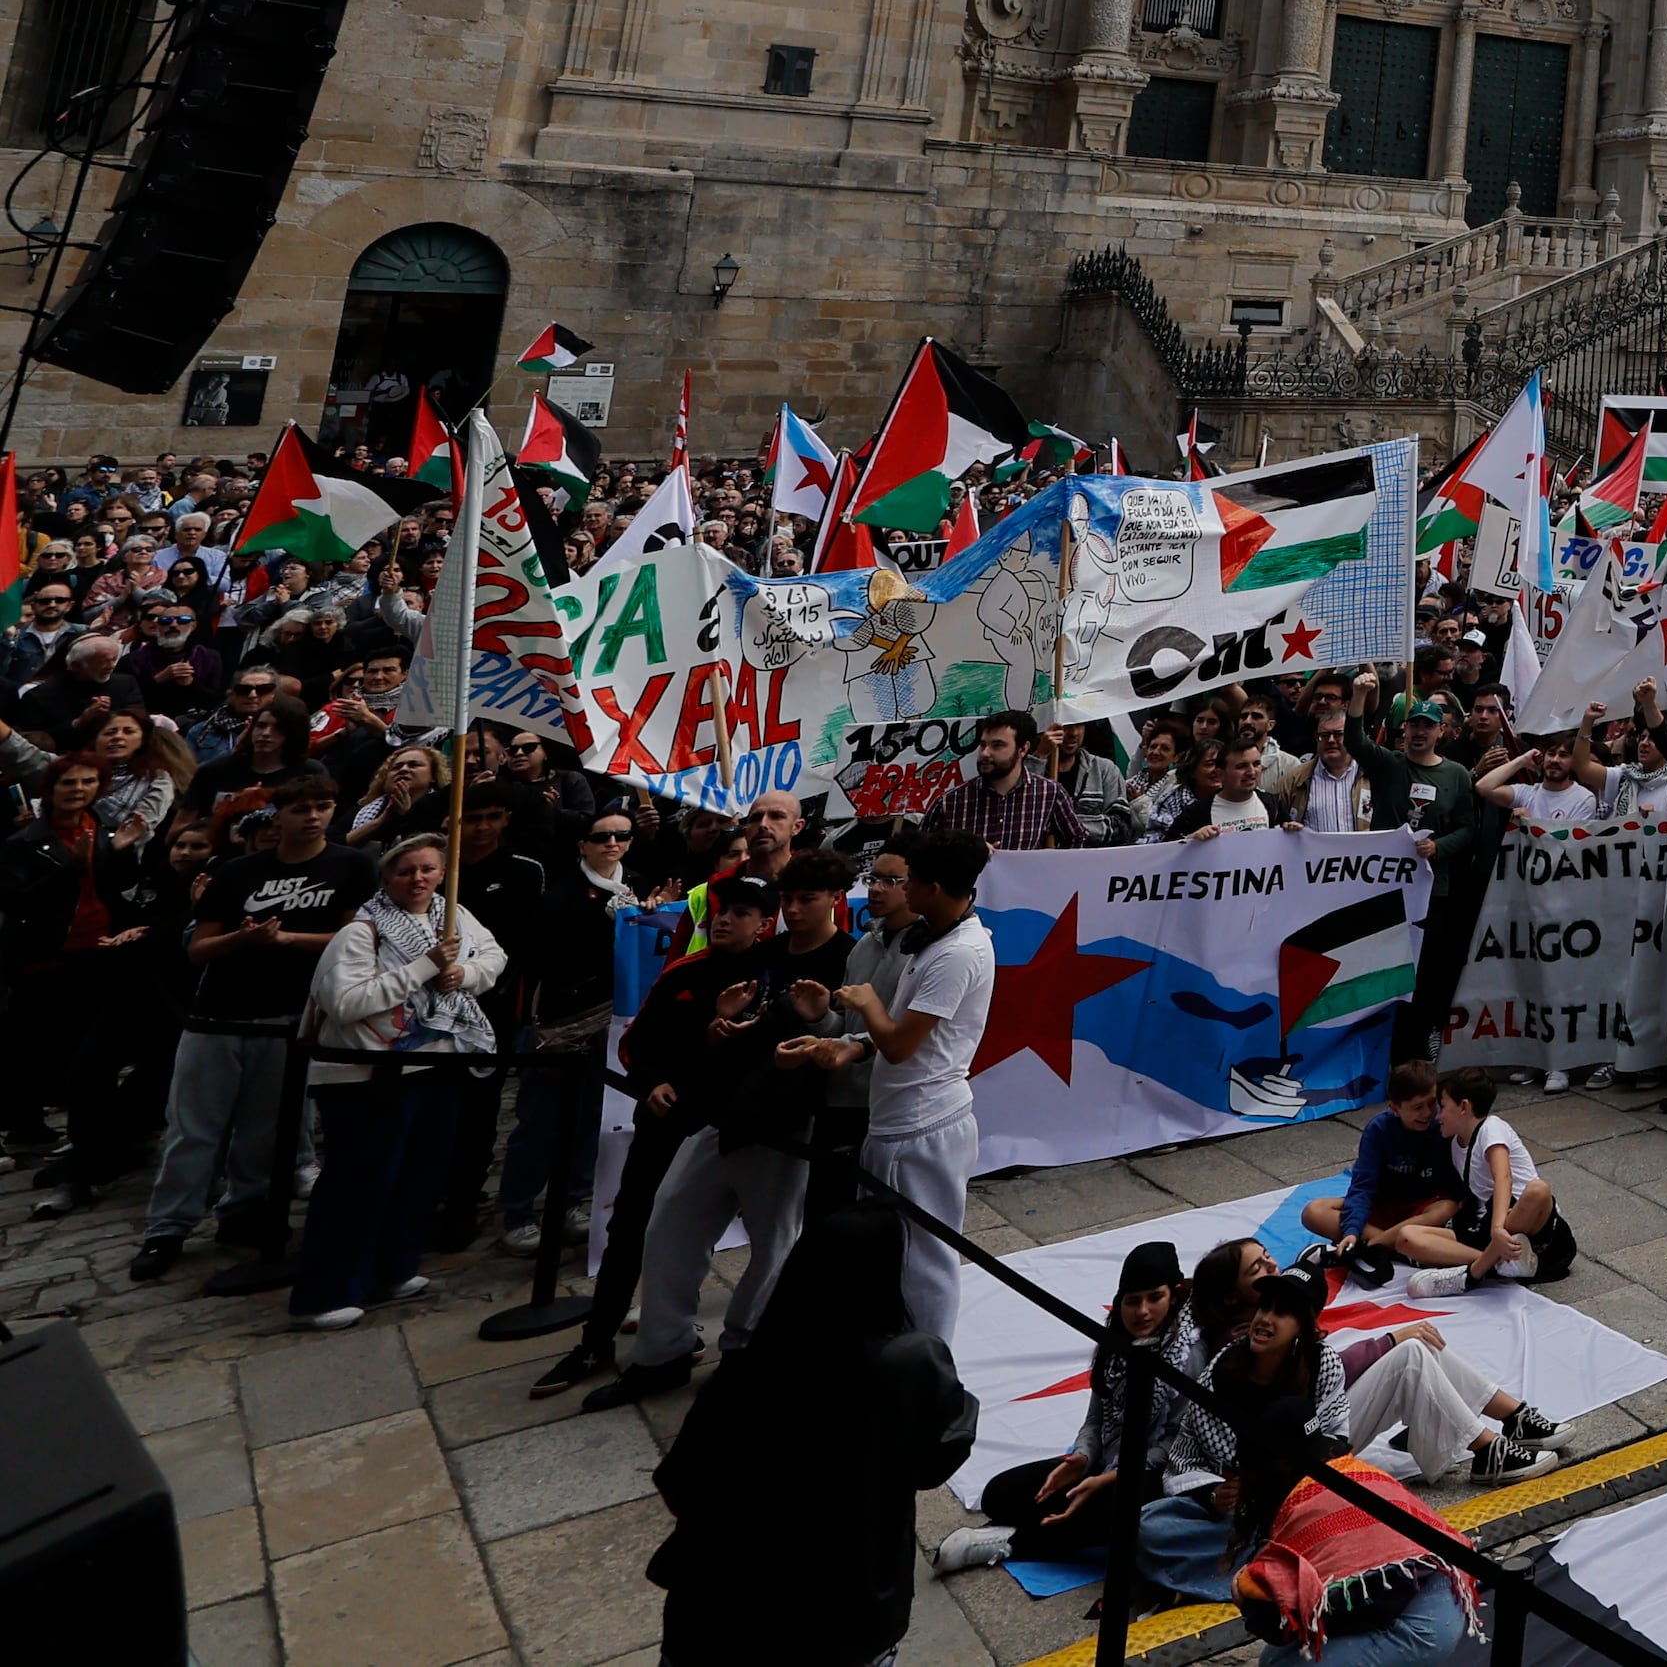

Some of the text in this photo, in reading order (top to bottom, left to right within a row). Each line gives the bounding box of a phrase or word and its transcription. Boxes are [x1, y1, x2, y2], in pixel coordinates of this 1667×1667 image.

[1534, 594, 1563, 640] 15
[863, 759, 964, 791] FOLGA
[257, 876, 308, 897] JUST
[1107, 854, 1418, 903] PALESTINA VENCER
[282, 889, 335, 911] DO IT
